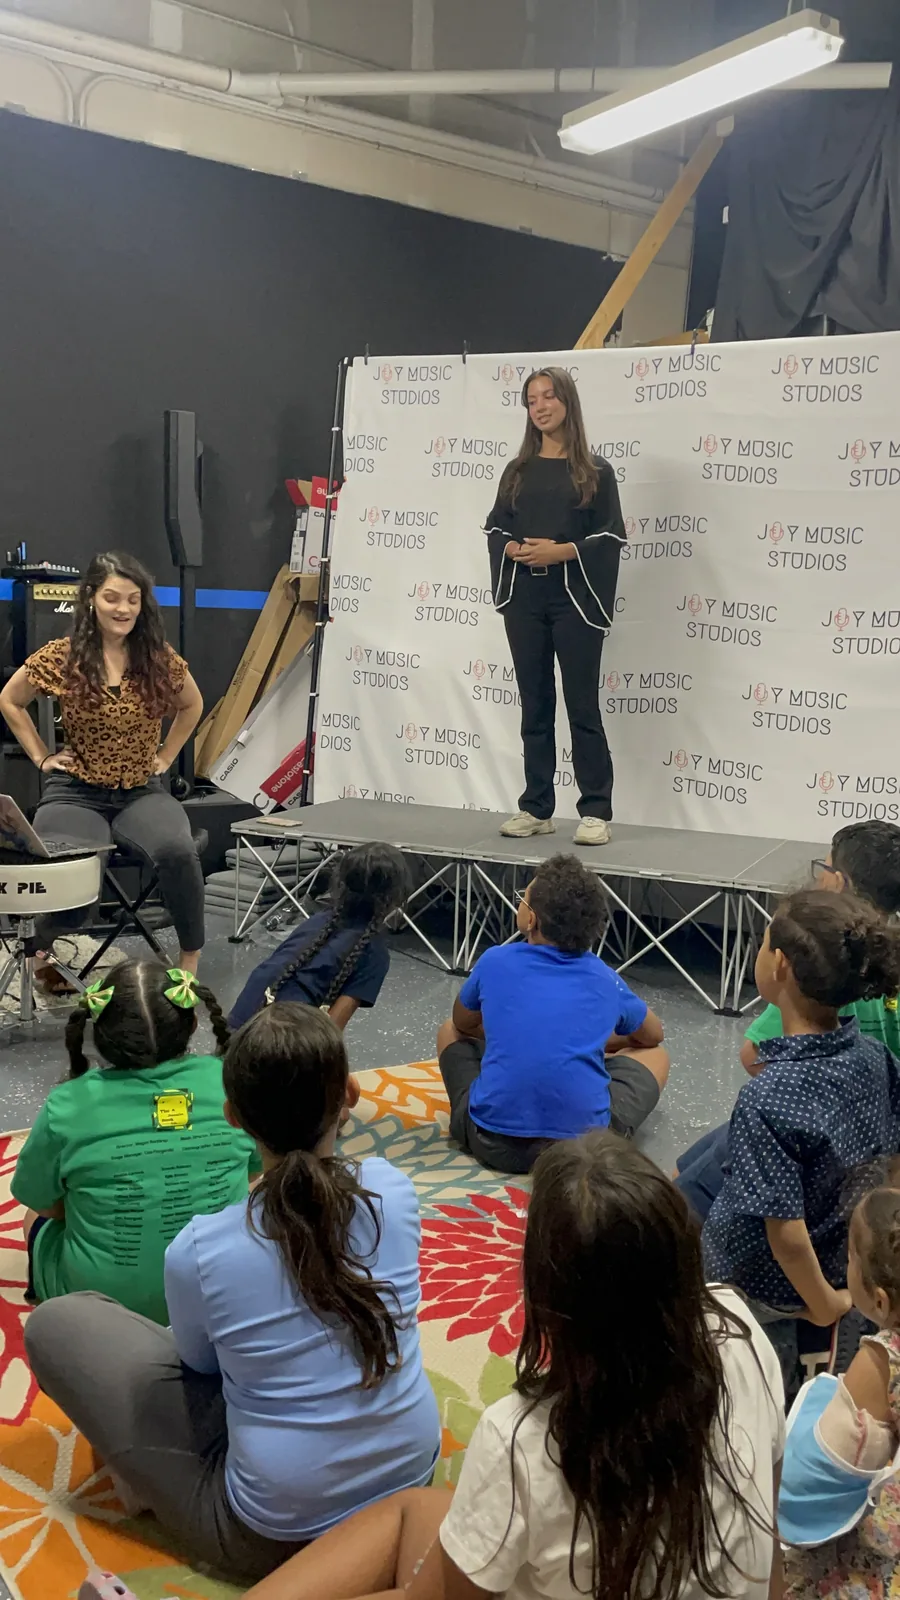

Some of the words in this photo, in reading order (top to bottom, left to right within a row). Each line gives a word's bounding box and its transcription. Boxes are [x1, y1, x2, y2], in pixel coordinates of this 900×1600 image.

[669, 354, 721, 372] MUSIC
[820, 355, 879, 375] MUSIC
[408, 365, 452, 381] MUSIC
[381, 390, 440, 405] STUDIOS
[635, 380, 706, 403] STUDIOS
[782, 384, 862, 402] STUDIOS
[347, 435, 387, 451] MUSIC
[462, 438, 508, 457] MUSIC
[591, 441, 640, 459] MUSIC
[738, 440, 793, 459] MUSIC
[345, 458, 374, 473] DIOS
[432, 462, 494, 480] STUDIOS
[702, 463, 777, 484] STUDIOS
[849, 468, 900, 487] STUD
[395, 511, 438, 526] MUSIC
[655, 516, 707, 533] MUSIC
[367, 531, 425, 549] STUDIOS
[805, 527, 864, 544] MUSIC
[621, 541, 692, 560] STUDIOS
[768, 551, 846, 571] STUDIOS
[333, 575, 372, 592] MUSIC
[446, 584, 493, 605] MUSIC
[331, 597, 359, 613] DIOS
[722, 601, 777, 622] MUSIC
[415, 606, 478, 626] STUDIOS
[686, 622, 761, 647] STUDIOS
[832, 637, 900, 654] STUDIO
[376, 651, 420, 669] MUSIC
[353, 670, 408, 690] STUDIOS
[640, 673, 692, 690] MUSIC
[472, 685, 522, 707] STUDI
[606, 697, 677, 713] STUDIOS
[790, 690, 847, 710] MUSIC
[322, 713, 360, 731] MUSIC
[753, 711, 831, 735] STUDIOS
[321, 735, 351, 751] DIOS
[435, 728, 480, 749] MUSIC
[405, 748, 468, 770] STUDIOS
[220, 758, 238, 781] CASIO
[270, 757, 304, 793] asiotone
[708, 758, 763, 781] MUSIC
[673, 777, 747, 804] STUDIOS
[856, 776, 898, 794] MUS
[817, 800, 899, 820] STUDIOS
[17, 882, 46, 894] PIE
